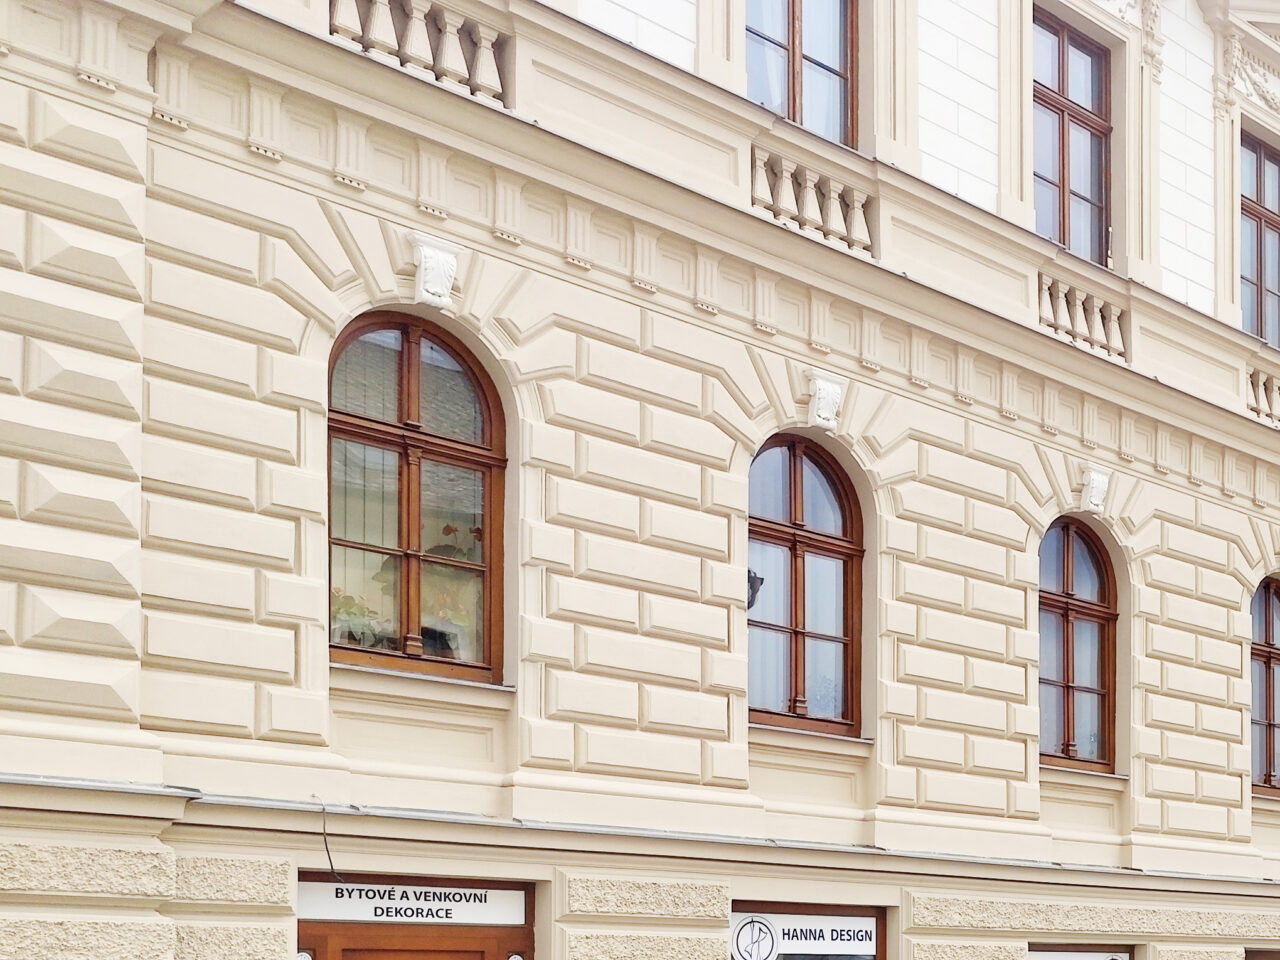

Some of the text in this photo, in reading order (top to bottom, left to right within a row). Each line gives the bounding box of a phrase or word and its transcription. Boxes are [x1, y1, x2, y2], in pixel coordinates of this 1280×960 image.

[335, 887, 488, 904] BYTOVÉ A VENKOVNÍ
[373, 906, 453, 919] DEKORACE
[782, 928, 873, 942] HANNA DESIGN
